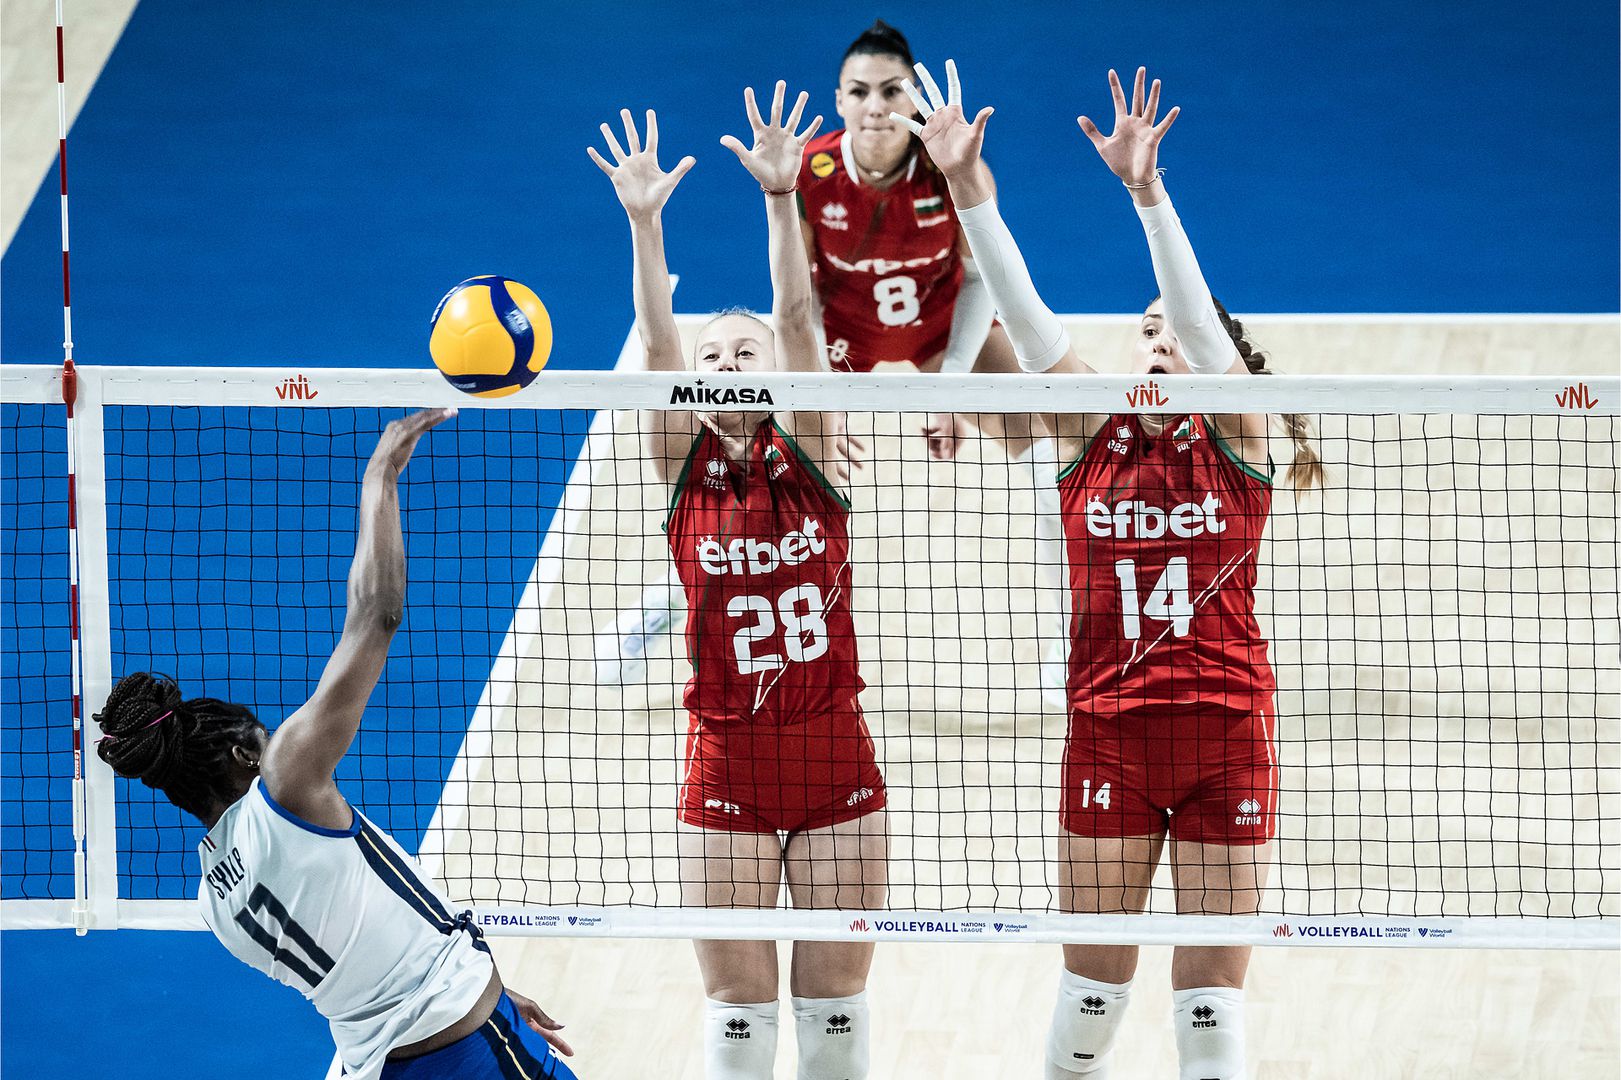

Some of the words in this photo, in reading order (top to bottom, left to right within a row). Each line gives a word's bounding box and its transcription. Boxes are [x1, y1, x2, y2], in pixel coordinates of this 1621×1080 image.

[874, 275, 921, 326] 8
[829, 338, 849, 362] 8
[275, 374, 318, 400] VNL
[670, 379, 774, 405] MIKASA
[1126, 380, 1169, 408] VNL
[1555, 382, 1599, 409] VNL
[1085, 491, 1227, 540] efbet
[697, 515, 826, 576] efbet
[1115, 556, 1194, 640] 14
[727, 582, 830, 675] 28
[1082, 779, 1111, 810] 14
[233, 882, 336, 988] 17
[850, 918, 870, 932] VNL
[875, 920, 958, 933] VOLLEYBALL
[1273, 923, 1294, 938] VNL
[1299, 926, 1383, 938] VOLLEYBALL
[1080, 1007, 1105, 1016] errea
[1192, 1019, 1217, 1028] errea
[725, 1031, 750, 1039] errea
[826, 1026, 851, 1035] errea
